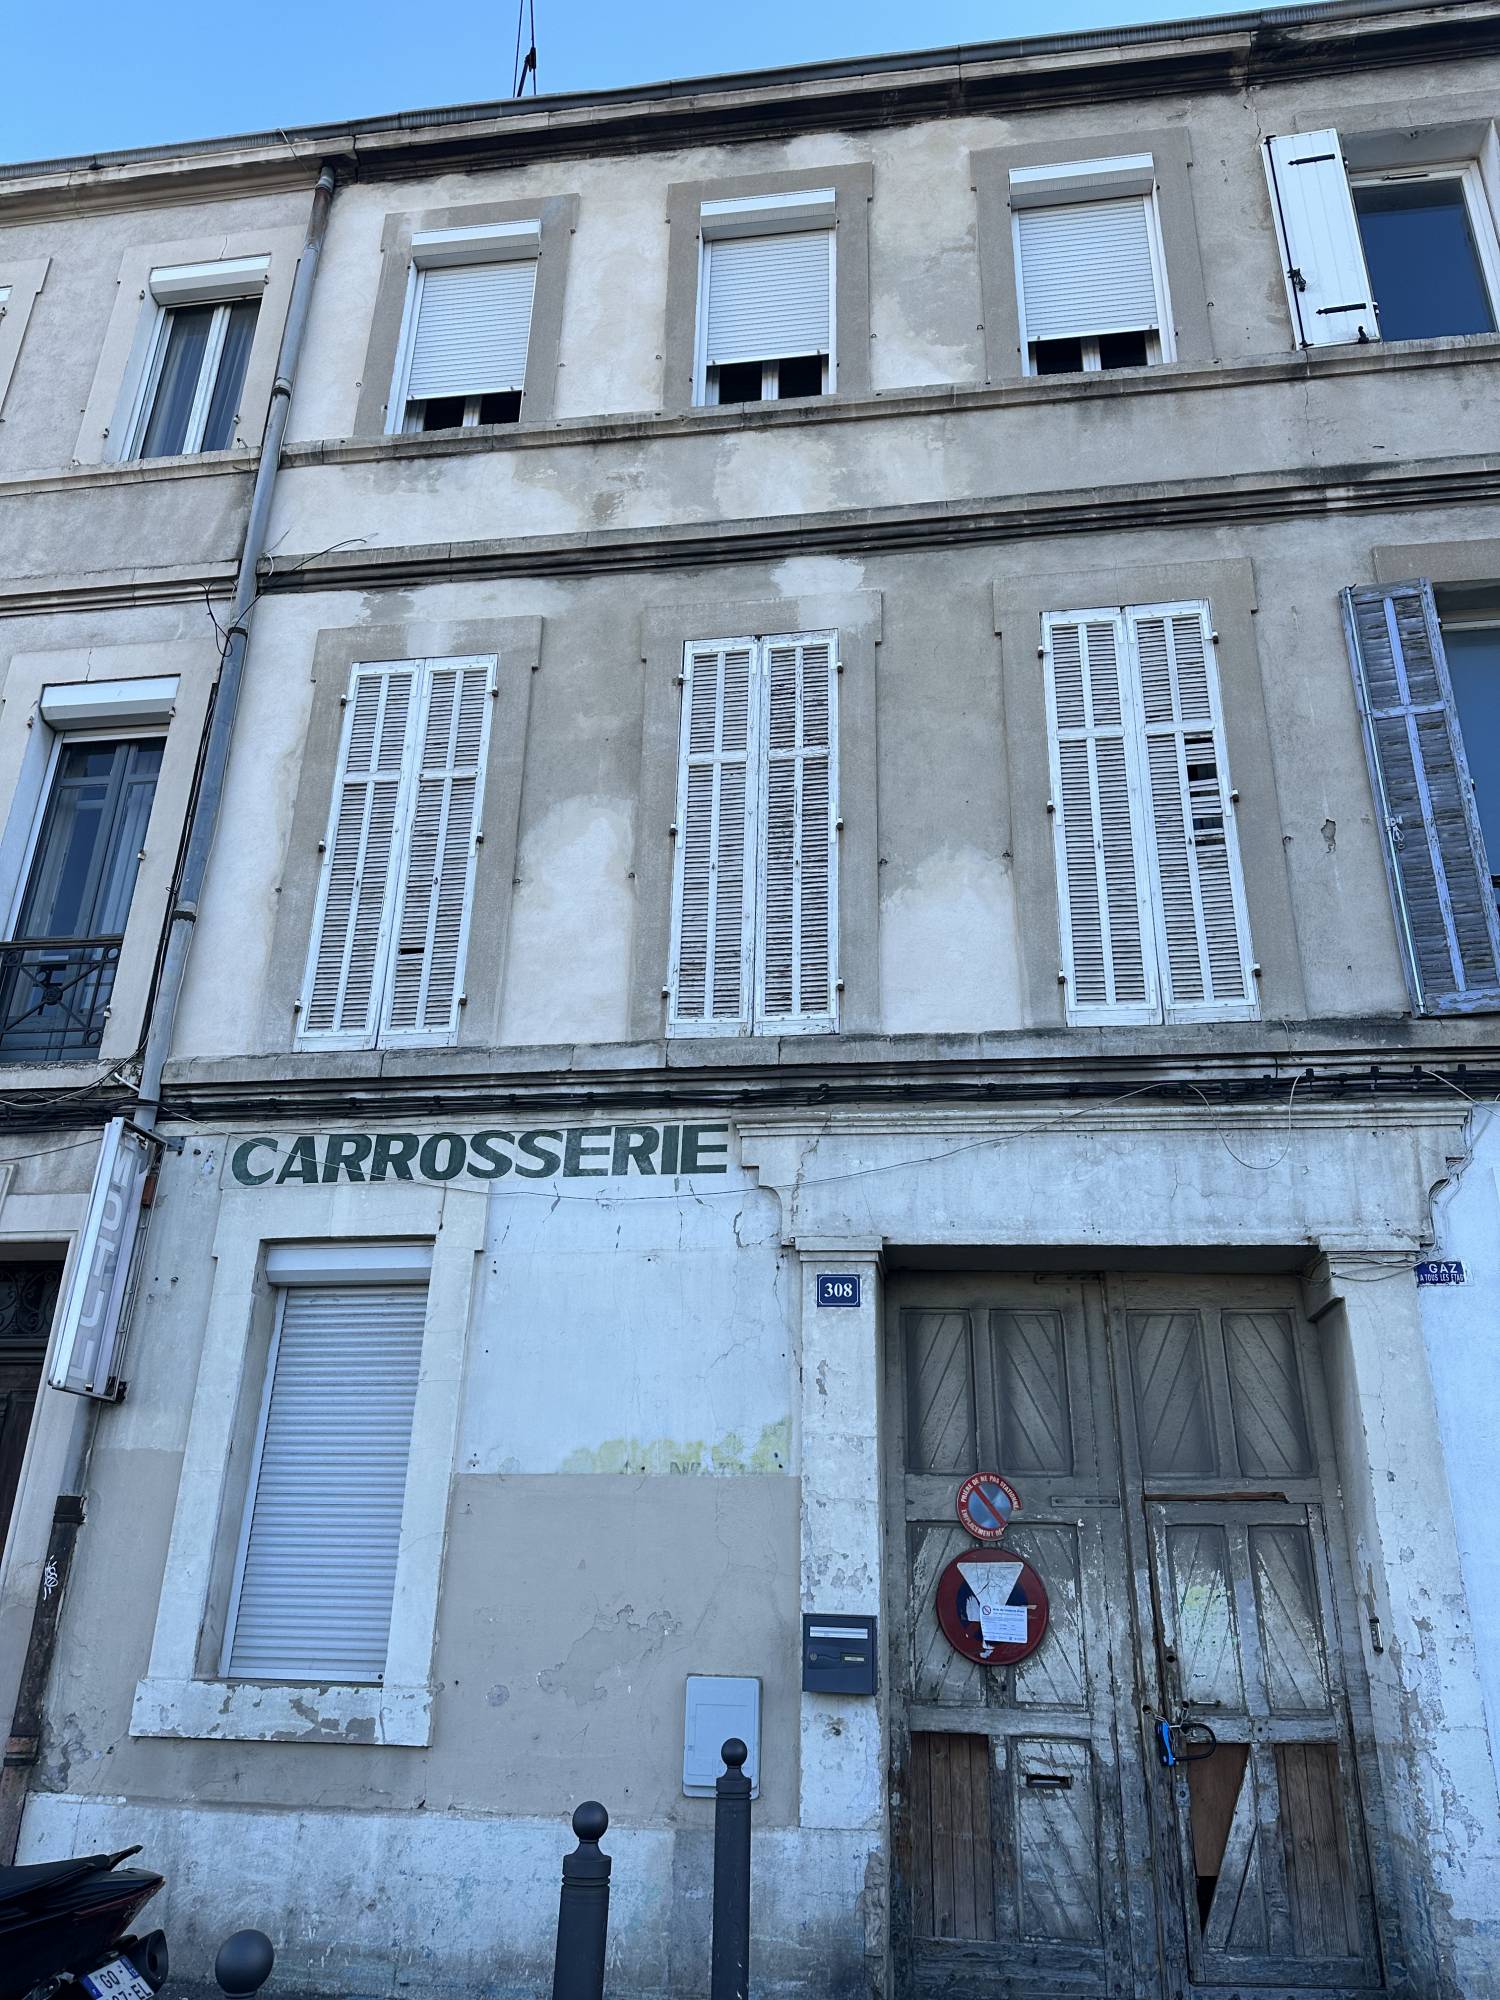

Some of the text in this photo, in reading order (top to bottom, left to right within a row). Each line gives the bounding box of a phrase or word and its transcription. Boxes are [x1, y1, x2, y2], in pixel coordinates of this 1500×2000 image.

[231, 1122, 729, 1187] CARROSSERIE
[1428, 1263, 1458, 1273] GAZ
[824, 1282, 853, 1297] 308
[971, 1477, 980, 1486] DE
[989, 1475, 1000, 1484] PAS
